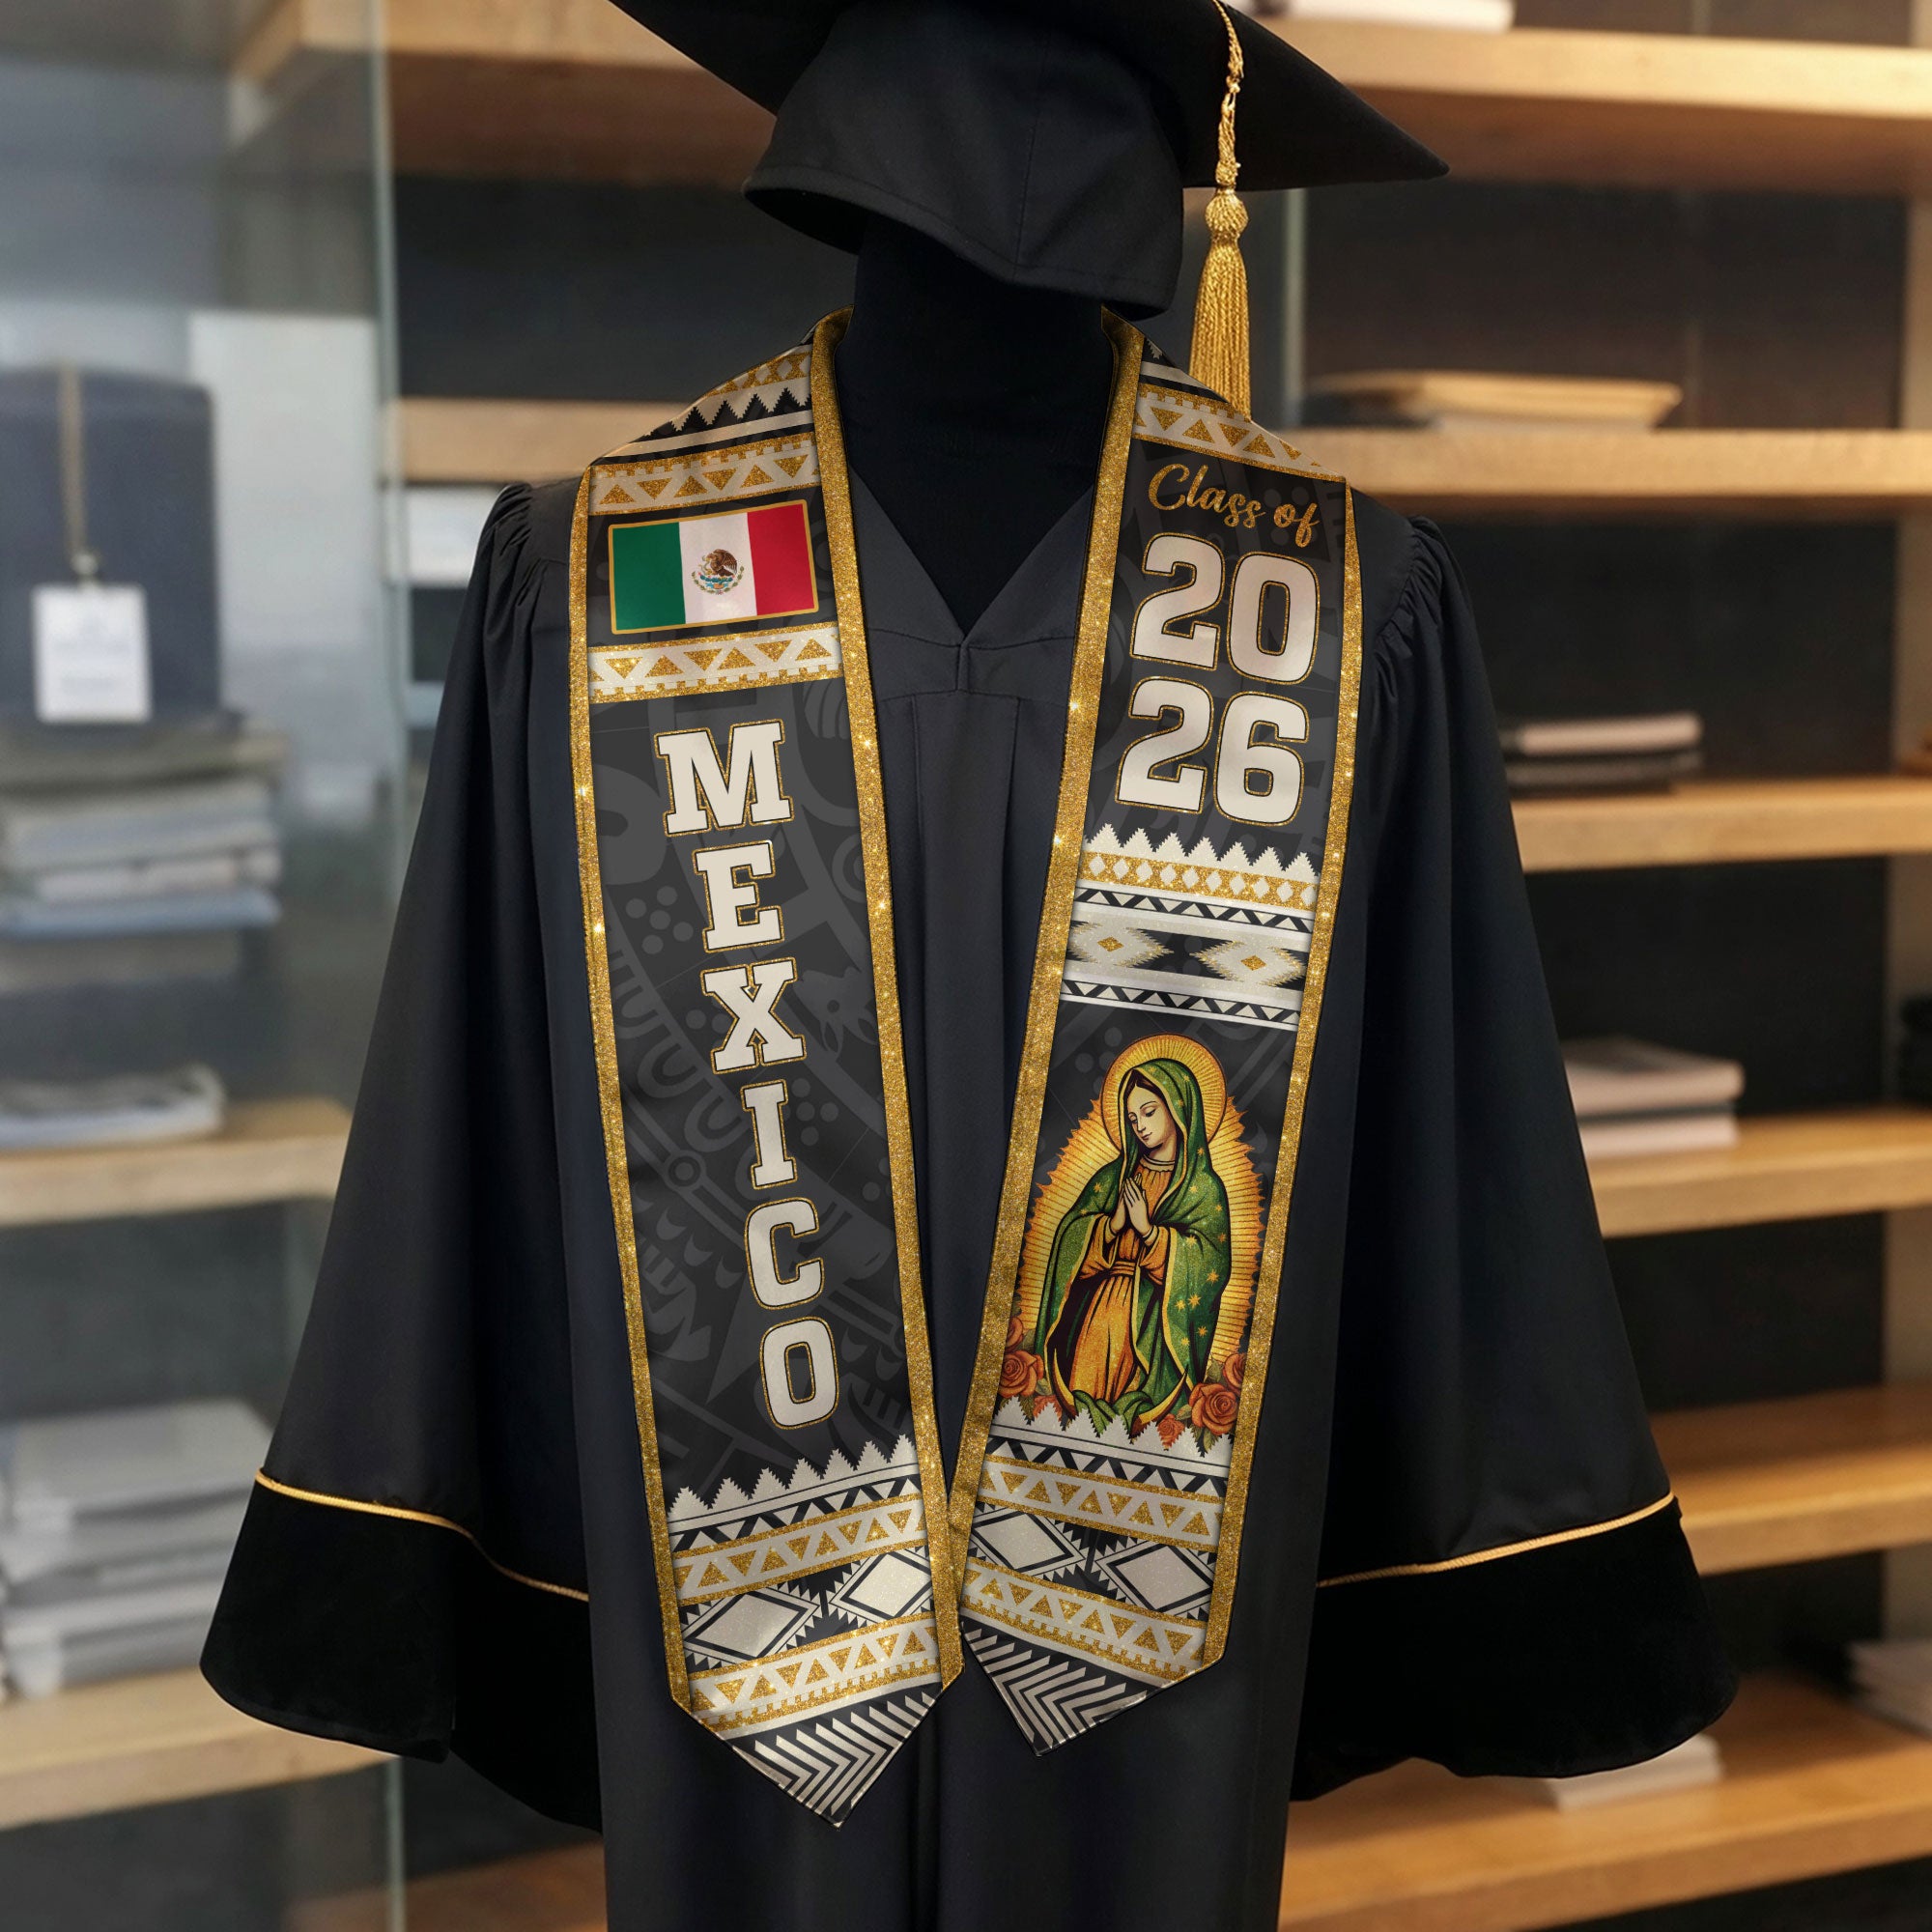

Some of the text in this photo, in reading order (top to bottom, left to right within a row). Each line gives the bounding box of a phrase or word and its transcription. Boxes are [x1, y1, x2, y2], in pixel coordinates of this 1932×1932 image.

[1149, 463, 1320, 548] Class of
[1129, 532, 1320, 685] 20
[1115, 676, 1310, 826] 26
[654, 719, 839, 1431] MEXICO
